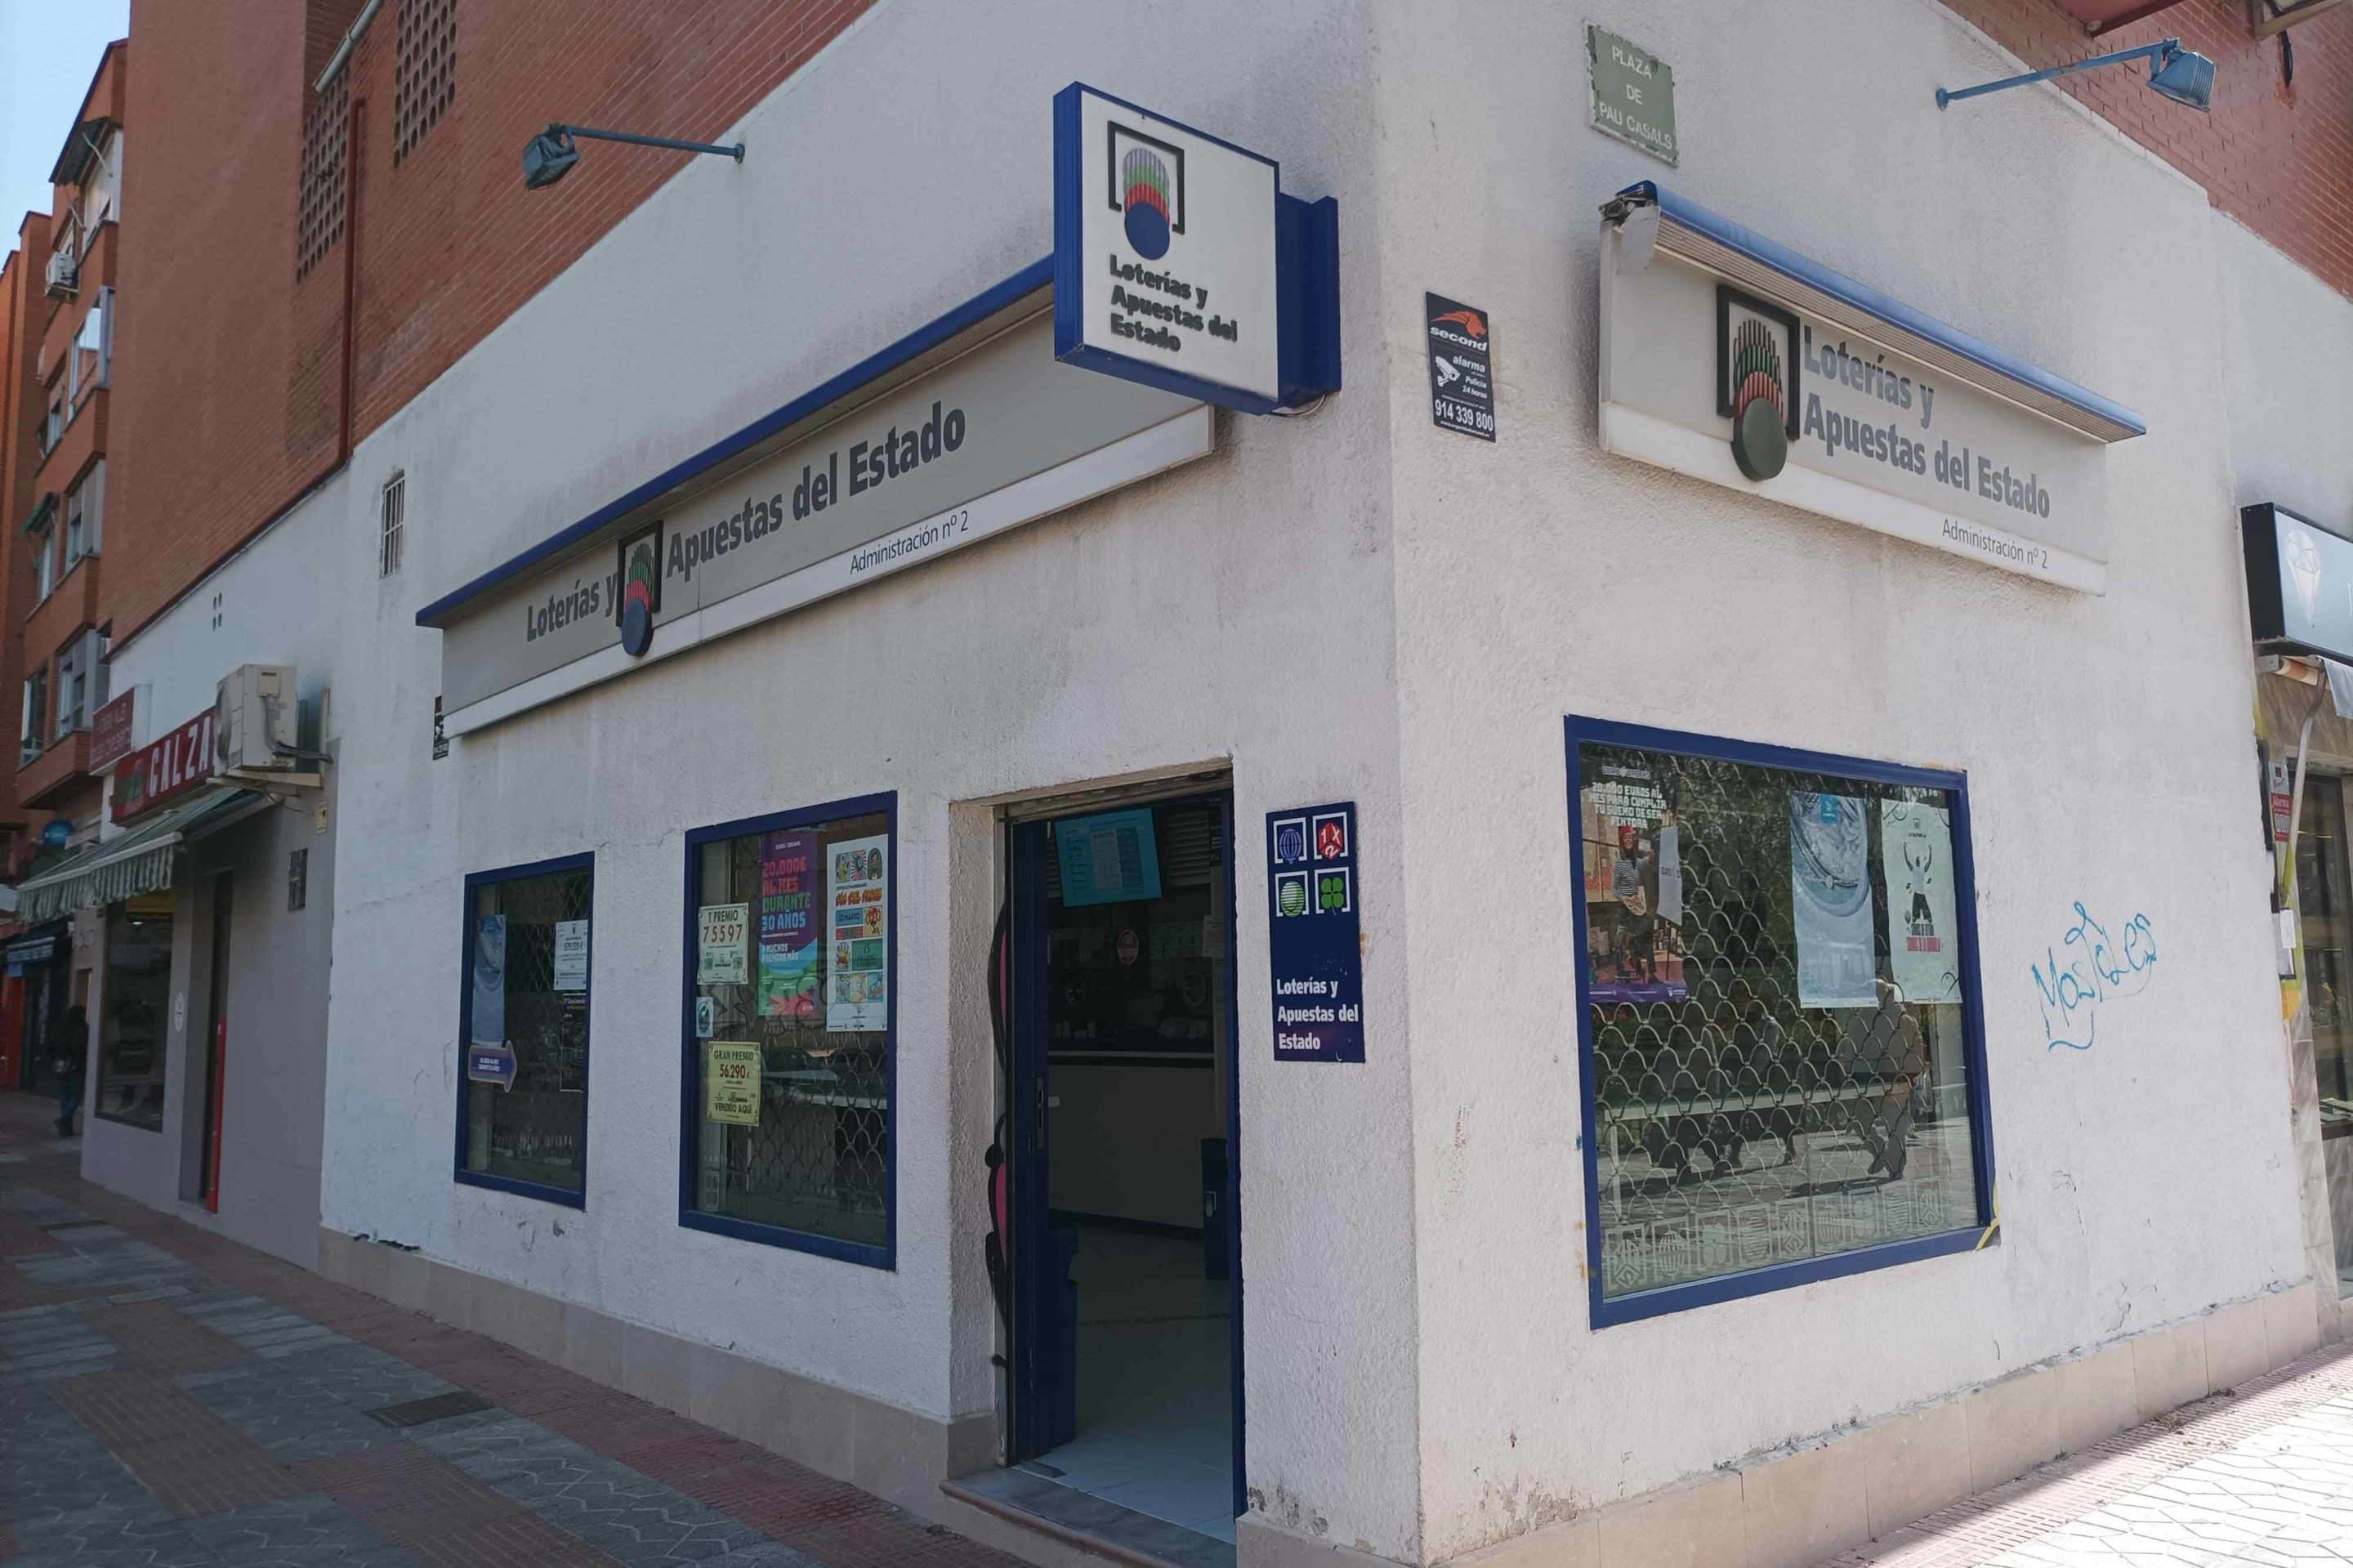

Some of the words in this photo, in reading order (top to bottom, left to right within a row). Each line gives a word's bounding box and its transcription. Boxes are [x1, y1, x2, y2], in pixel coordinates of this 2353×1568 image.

[1611, 45, 1652, 79] PLAZA
[1626, 84, 1643, 105] DE
[1599, 101, 1623, 126] PAU
[1627, 116, 1672, 150] CASALS
[1110, 254, 1191, 300] Loterías
[1195, 287, 1208, 310] y
[1111, 284, 1204, 332] Apuestas
[1208, 315, 1238, 343] del
[1110, 313, 1181, 352] Estado
[1430, 326, 1488, 352] second
[1453, 355, 1486, 373] alarma
[1803, 324, 1913, 410] Loterías
[1920, 383, 1935, 429] y
[1462, 385, 1471, 394] 24
[1471, 387, 1488, 400] horas
[1435, 399, 1454, 420] 914
[1455, 404, 1474, 426] 339
[1476, 410, 1494, 432] 800
[1803, 392, 1927, 476] Apuestas
[1934, 439, 1971, 491] del
[1978, 454, 2052, 519] Estado
[527, 579, 600, 642] Loterías
[605, 572, 618, 618] y
[666, 493, 784, 583] Apuestas
[793, 451, 838, 521] del
[850, 400, 967, 497] Estado
[850, 525, 940, 574] Administración
[961, 510, 969, 531] 2
[1942, 518, 2025, 563] Administración
[2041, 550, 2048, 569] 2
[149, 715, 212, 797] CALZA
[1624, 784, 1650, 798] EUROS
[1595, 804, 1605, 815] TU
[1635, 807, 1646, 819] DE
[1320, 829, 1327, 844] 1
[1332, 825, 1341, 845] X
[761, 891, 811, 914] DURANTE
[714, 909, 739, 922] PREMIO
[761, 914, 775, 931] 30
[777, 909, 806, 930] AÑOS
[703, 923, 743, 943] 75597
[1276, 976, 1327, 995] Loterías
[1330, 979, 1338, 998] y
[1277, 1005, 1335, 1026] Apuestas
[1338, 1003, 1359, 1023] del
[1279, 1031, 1321, 1051] Estado
[714, 1050, 730, 1060] GRAN
[732, 1051, 754, 1061] PREMIO
[720, 1064, 745, 1079] 56.290
